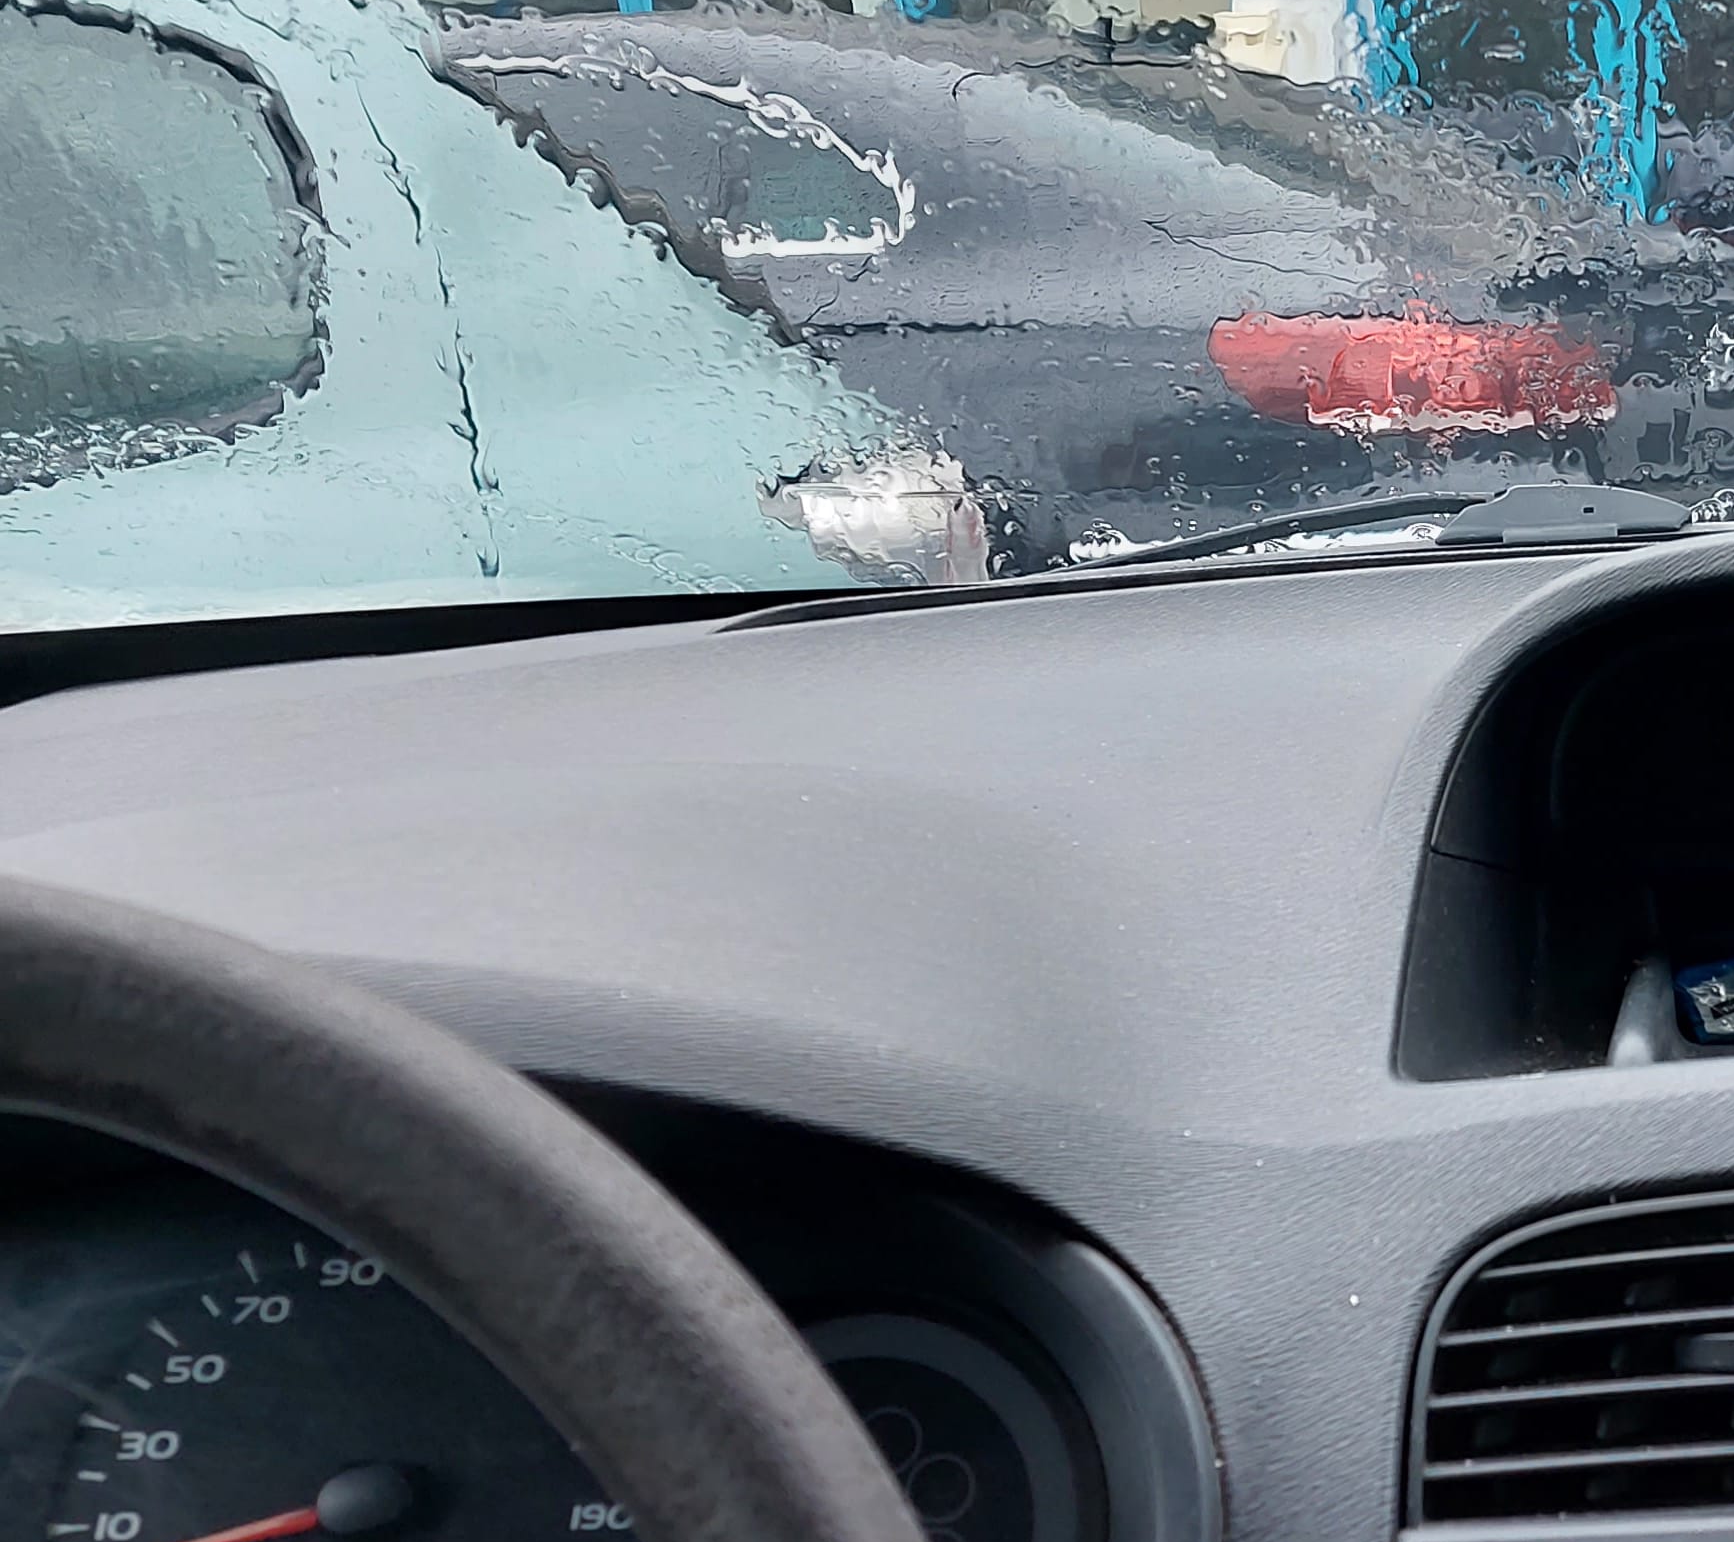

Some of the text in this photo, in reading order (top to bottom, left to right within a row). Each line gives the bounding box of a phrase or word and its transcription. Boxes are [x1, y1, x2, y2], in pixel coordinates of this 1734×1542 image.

[320, 1258, 384, 1287] 90
[232, 1295, 291, 1325] 70
[164, 1354, 226, 1384] 50
[116, 1430, 180, 1461] 30
[94, 1512, 142, 1542] 10
